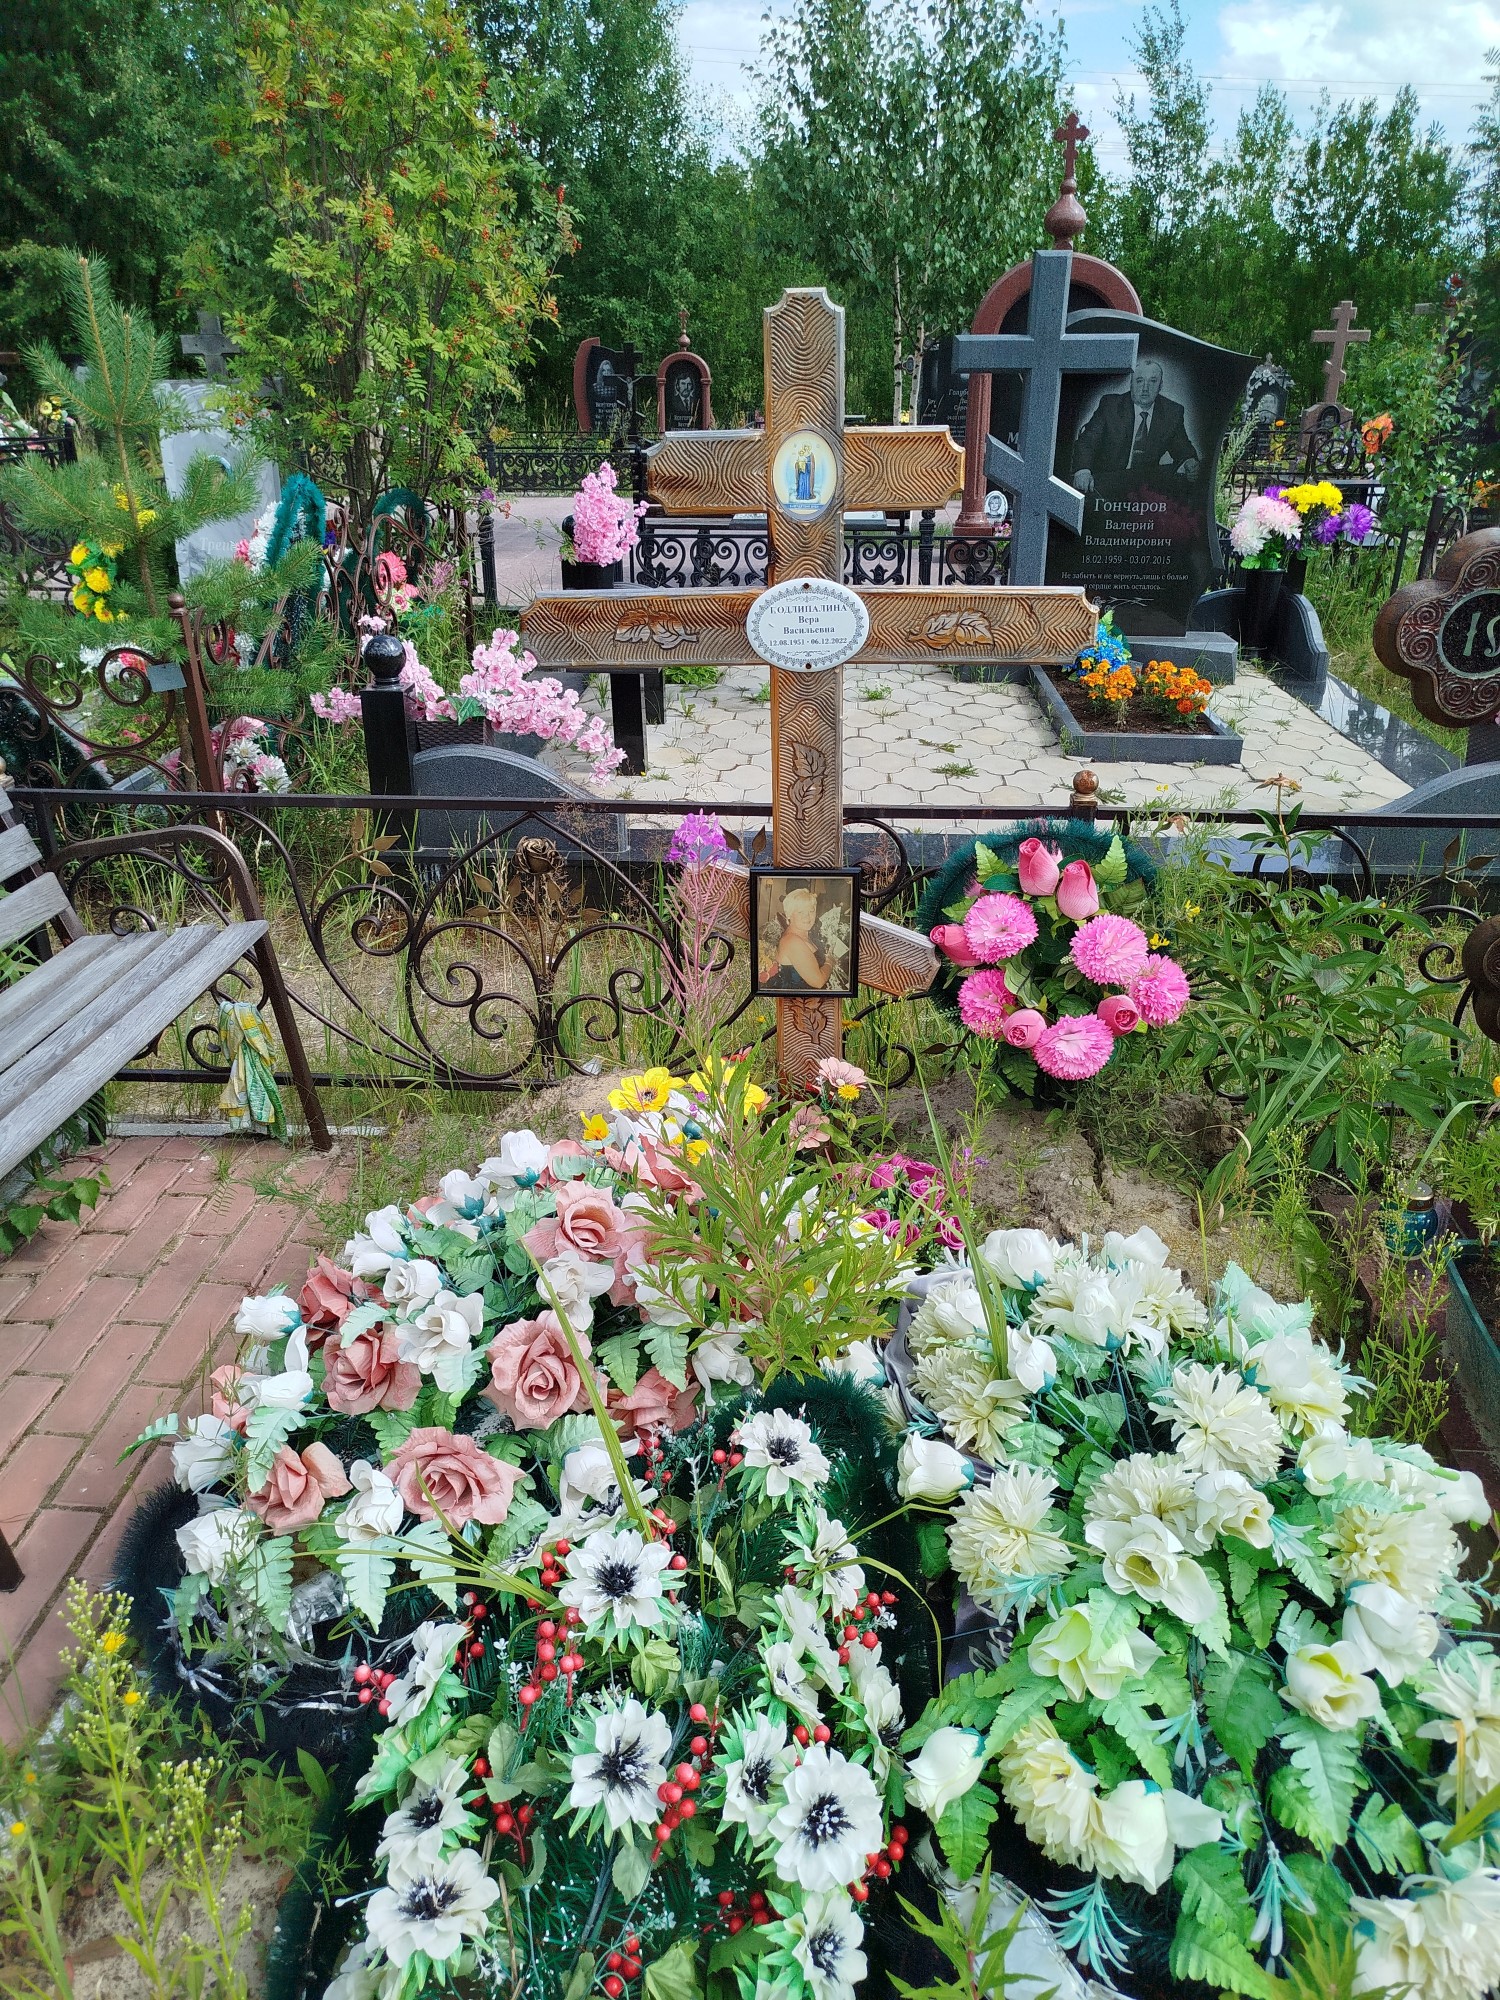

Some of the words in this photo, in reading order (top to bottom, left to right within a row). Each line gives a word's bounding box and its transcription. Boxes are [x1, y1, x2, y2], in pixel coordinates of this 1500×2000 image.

[1093, 498, 1167, 516] Гончаров
[1105, 519, 1155, 533] Валерий
[1085, 535, 1172, 549] Владимирович
[1082, 555, 1123, 564] 18.02.1959
[1129, 555, 1171, 564] 03.07.2015
[798, 615, 819, 625] Вера
[783, 626, 835, 635] Васильевна
